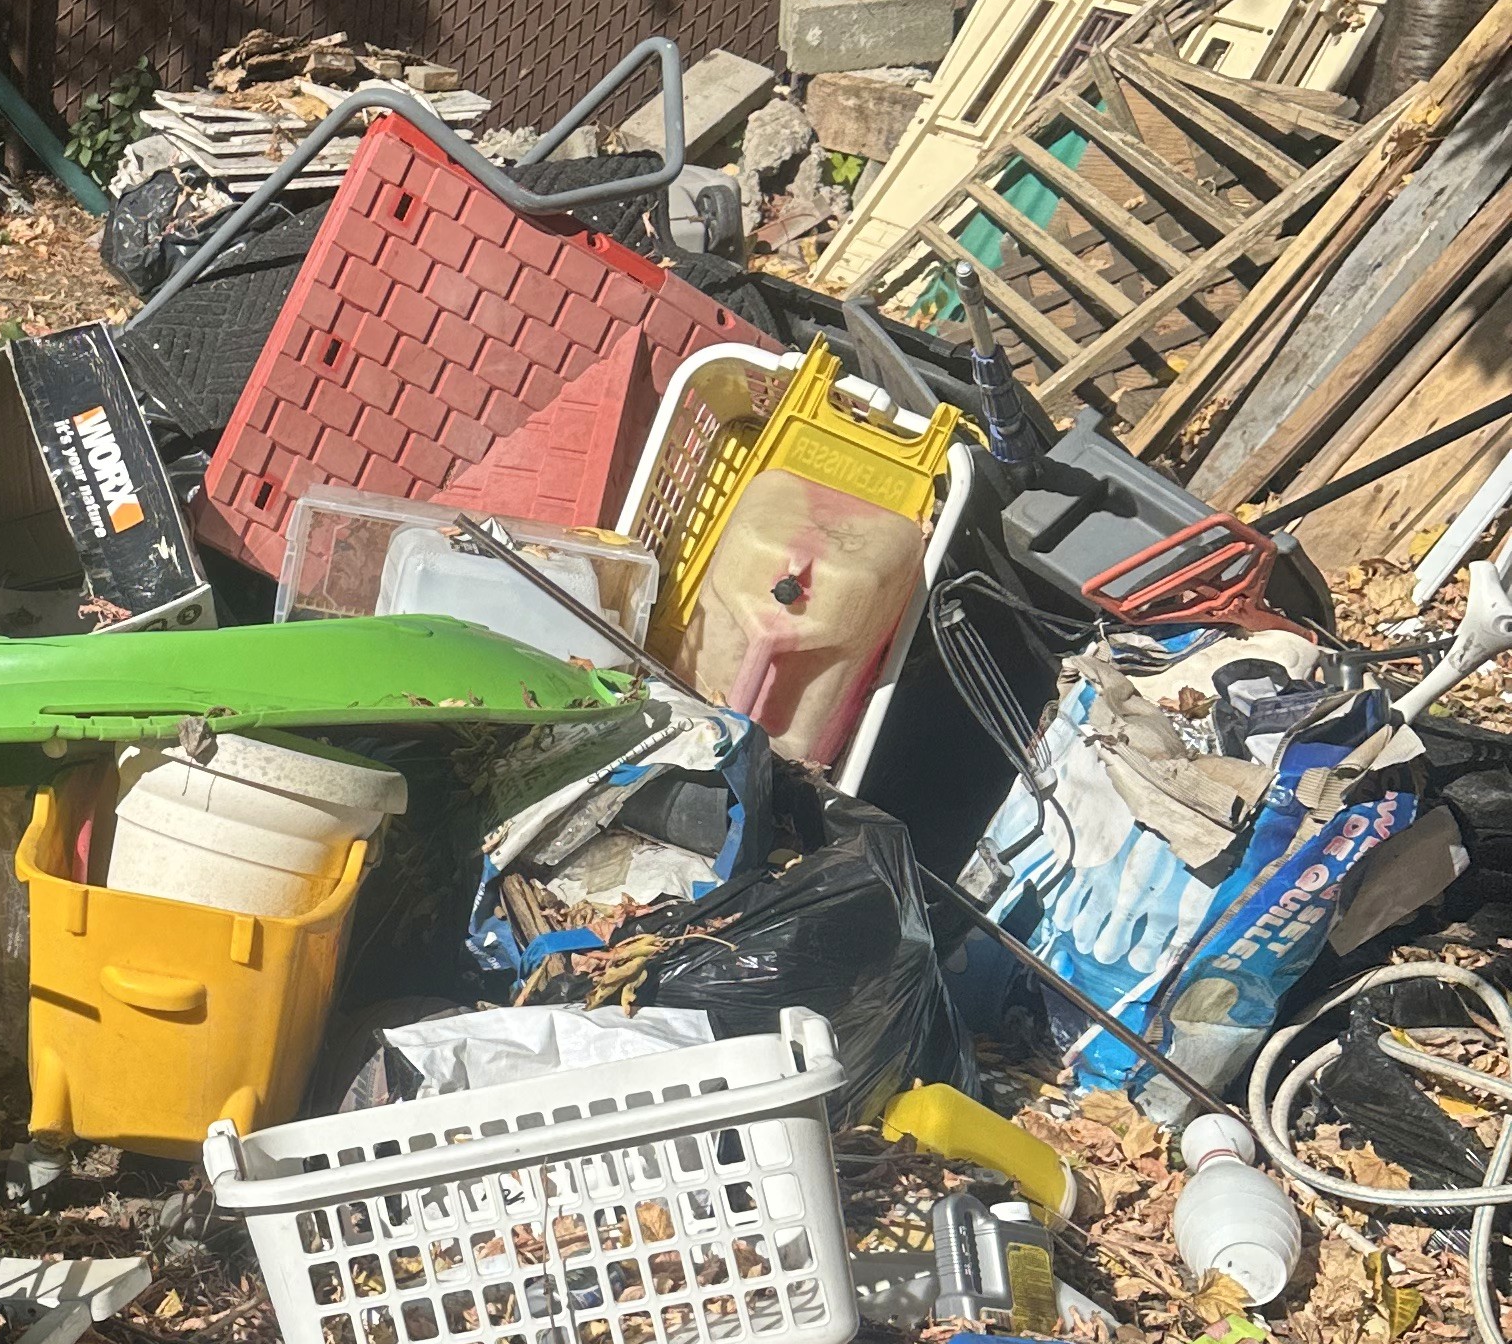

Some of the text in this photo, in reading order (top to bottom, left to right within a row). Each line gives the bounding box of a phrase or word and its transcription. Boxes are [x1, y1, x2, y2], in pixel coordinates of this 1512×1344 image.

[53, 418, 107, 538] it's your nature
[75, 407, 140, 517] WORX
[1211, 813, 1370, 971] DE QUILLES
[1266, 904, 1327, 959] SET
